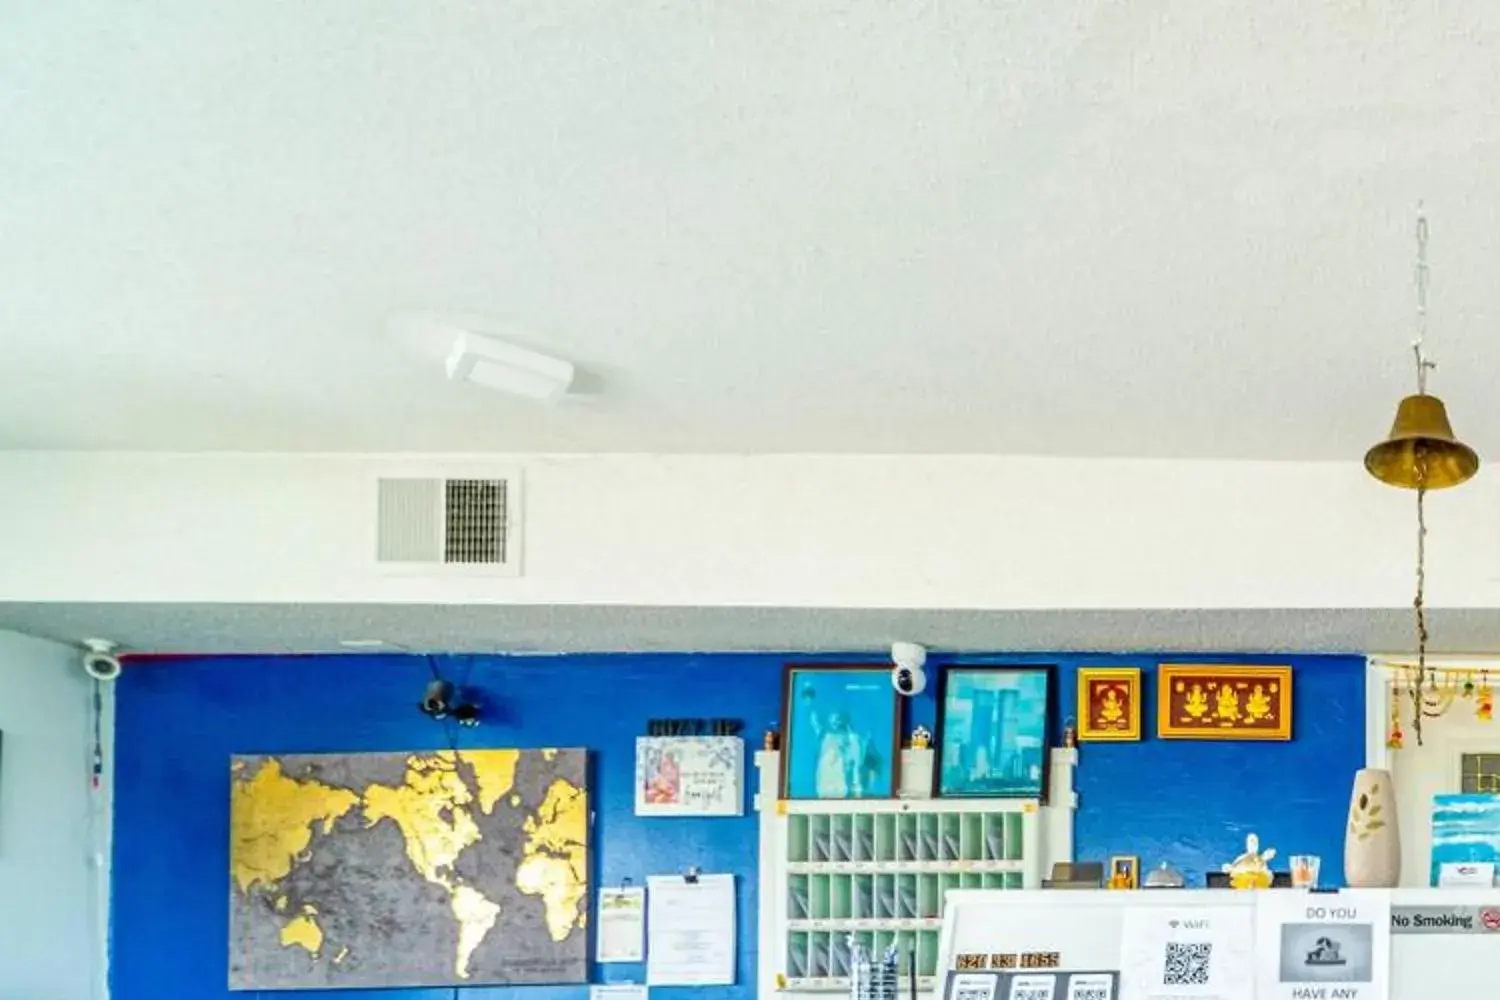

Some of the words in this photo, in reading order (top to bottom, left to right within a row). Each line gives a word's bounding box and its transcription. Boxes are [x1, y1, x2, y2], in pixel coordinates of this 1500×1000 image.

[1306, 907, 1326, 919] DO
[1330, 907, 1357, 919] YOU
[1391, 914, 1410, 927] No
[1413, 914, 1473, 929] Smoking
[1292, 988, 1326, 1000] HAVE
[1331, 988, 1358, 999] ANY
